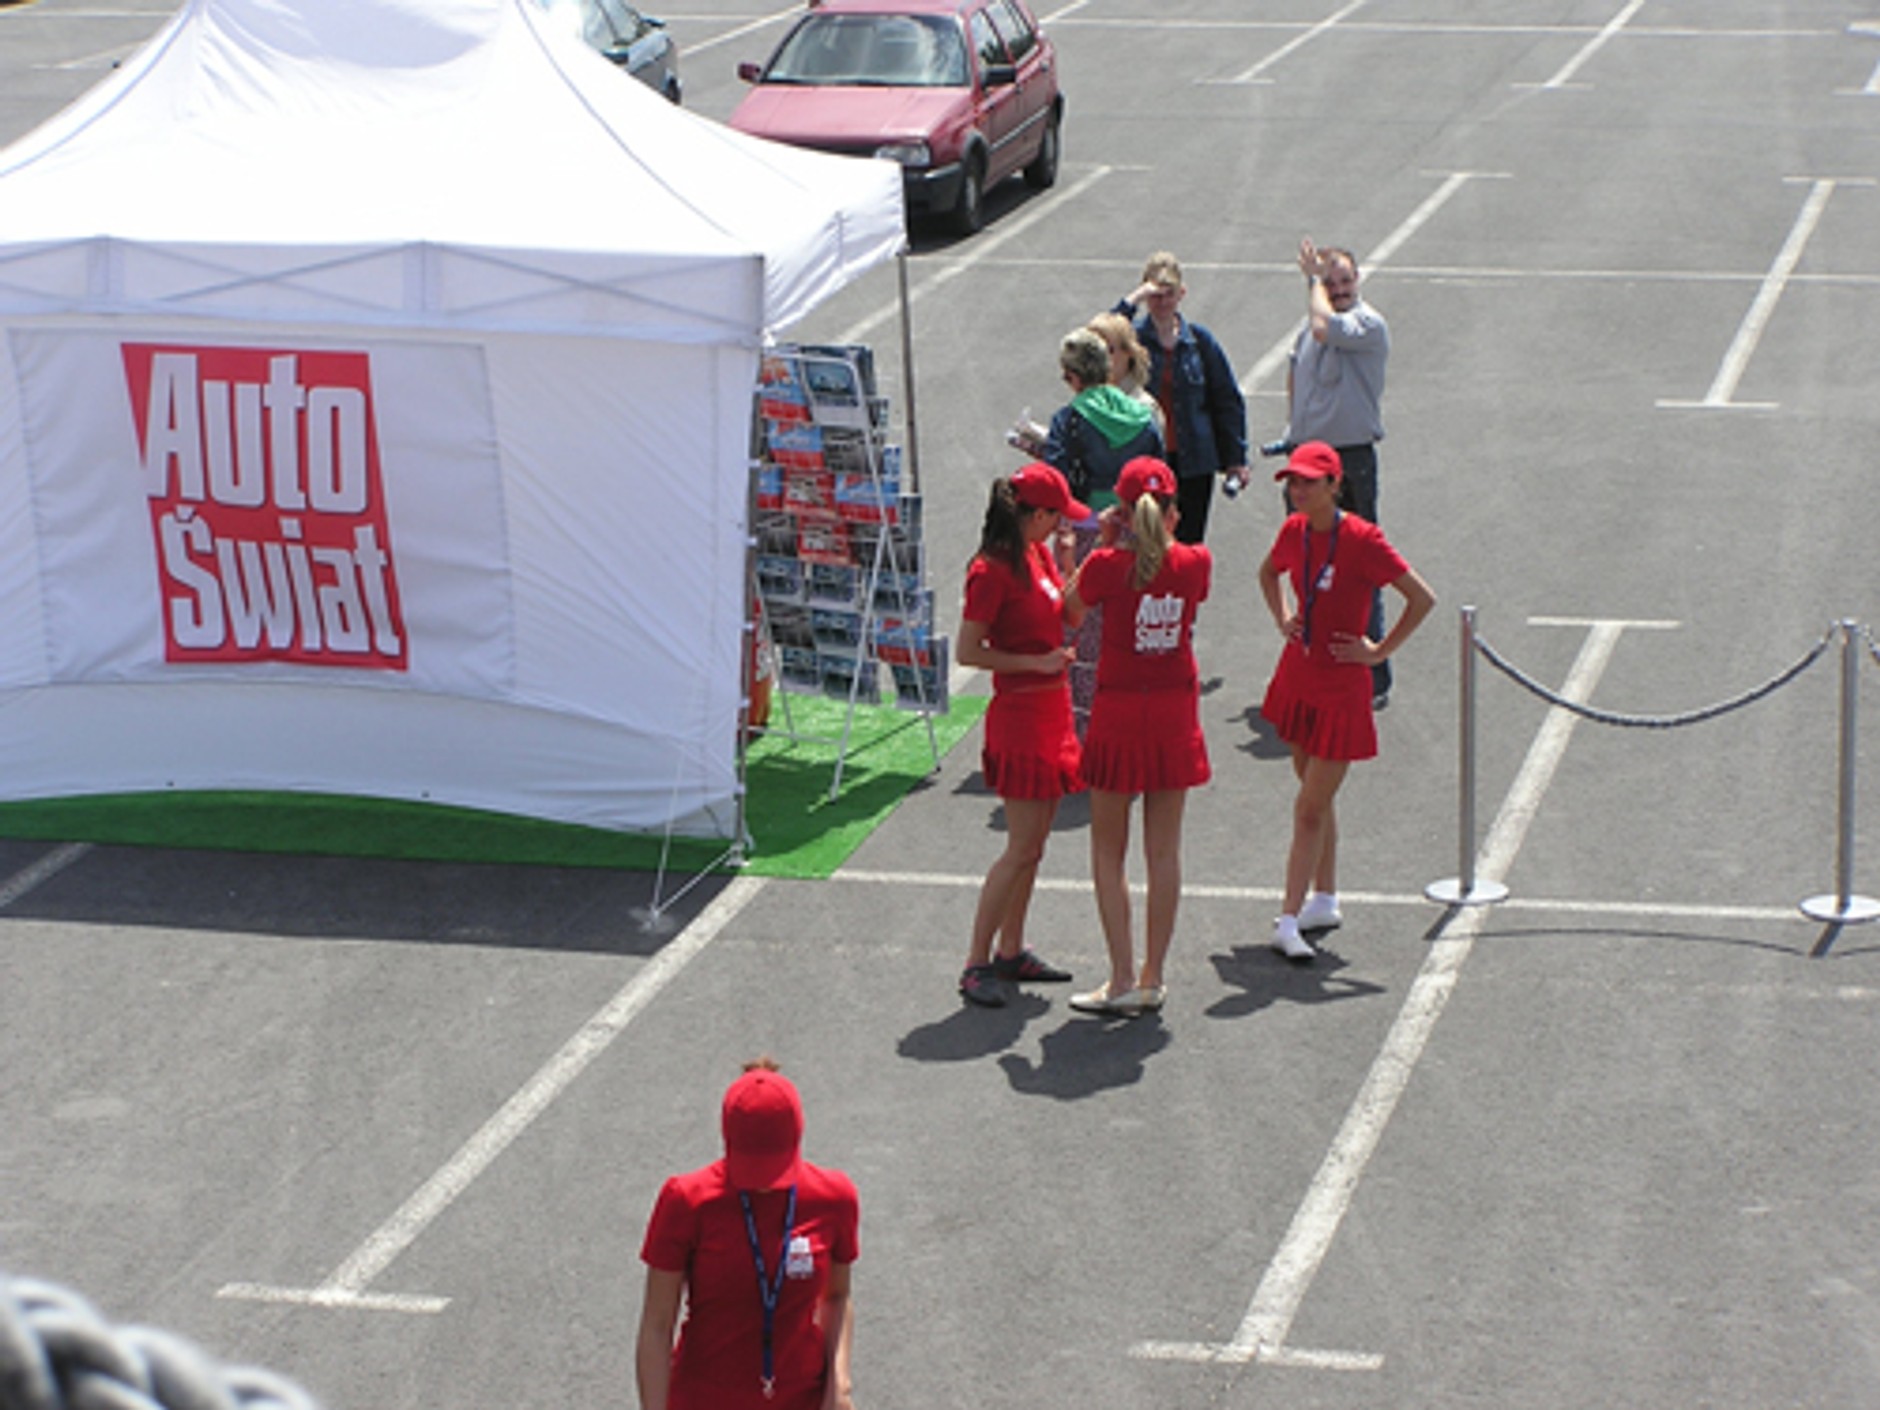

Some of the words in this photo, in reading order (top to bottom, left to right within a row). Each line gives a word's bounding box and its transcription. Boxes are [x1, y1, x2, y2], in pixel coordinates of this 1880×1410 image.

[147, 353, 367, 513] Auto
[160, 505, 402, 656] Świat
[1136, 594, 1185, 625] Auto
